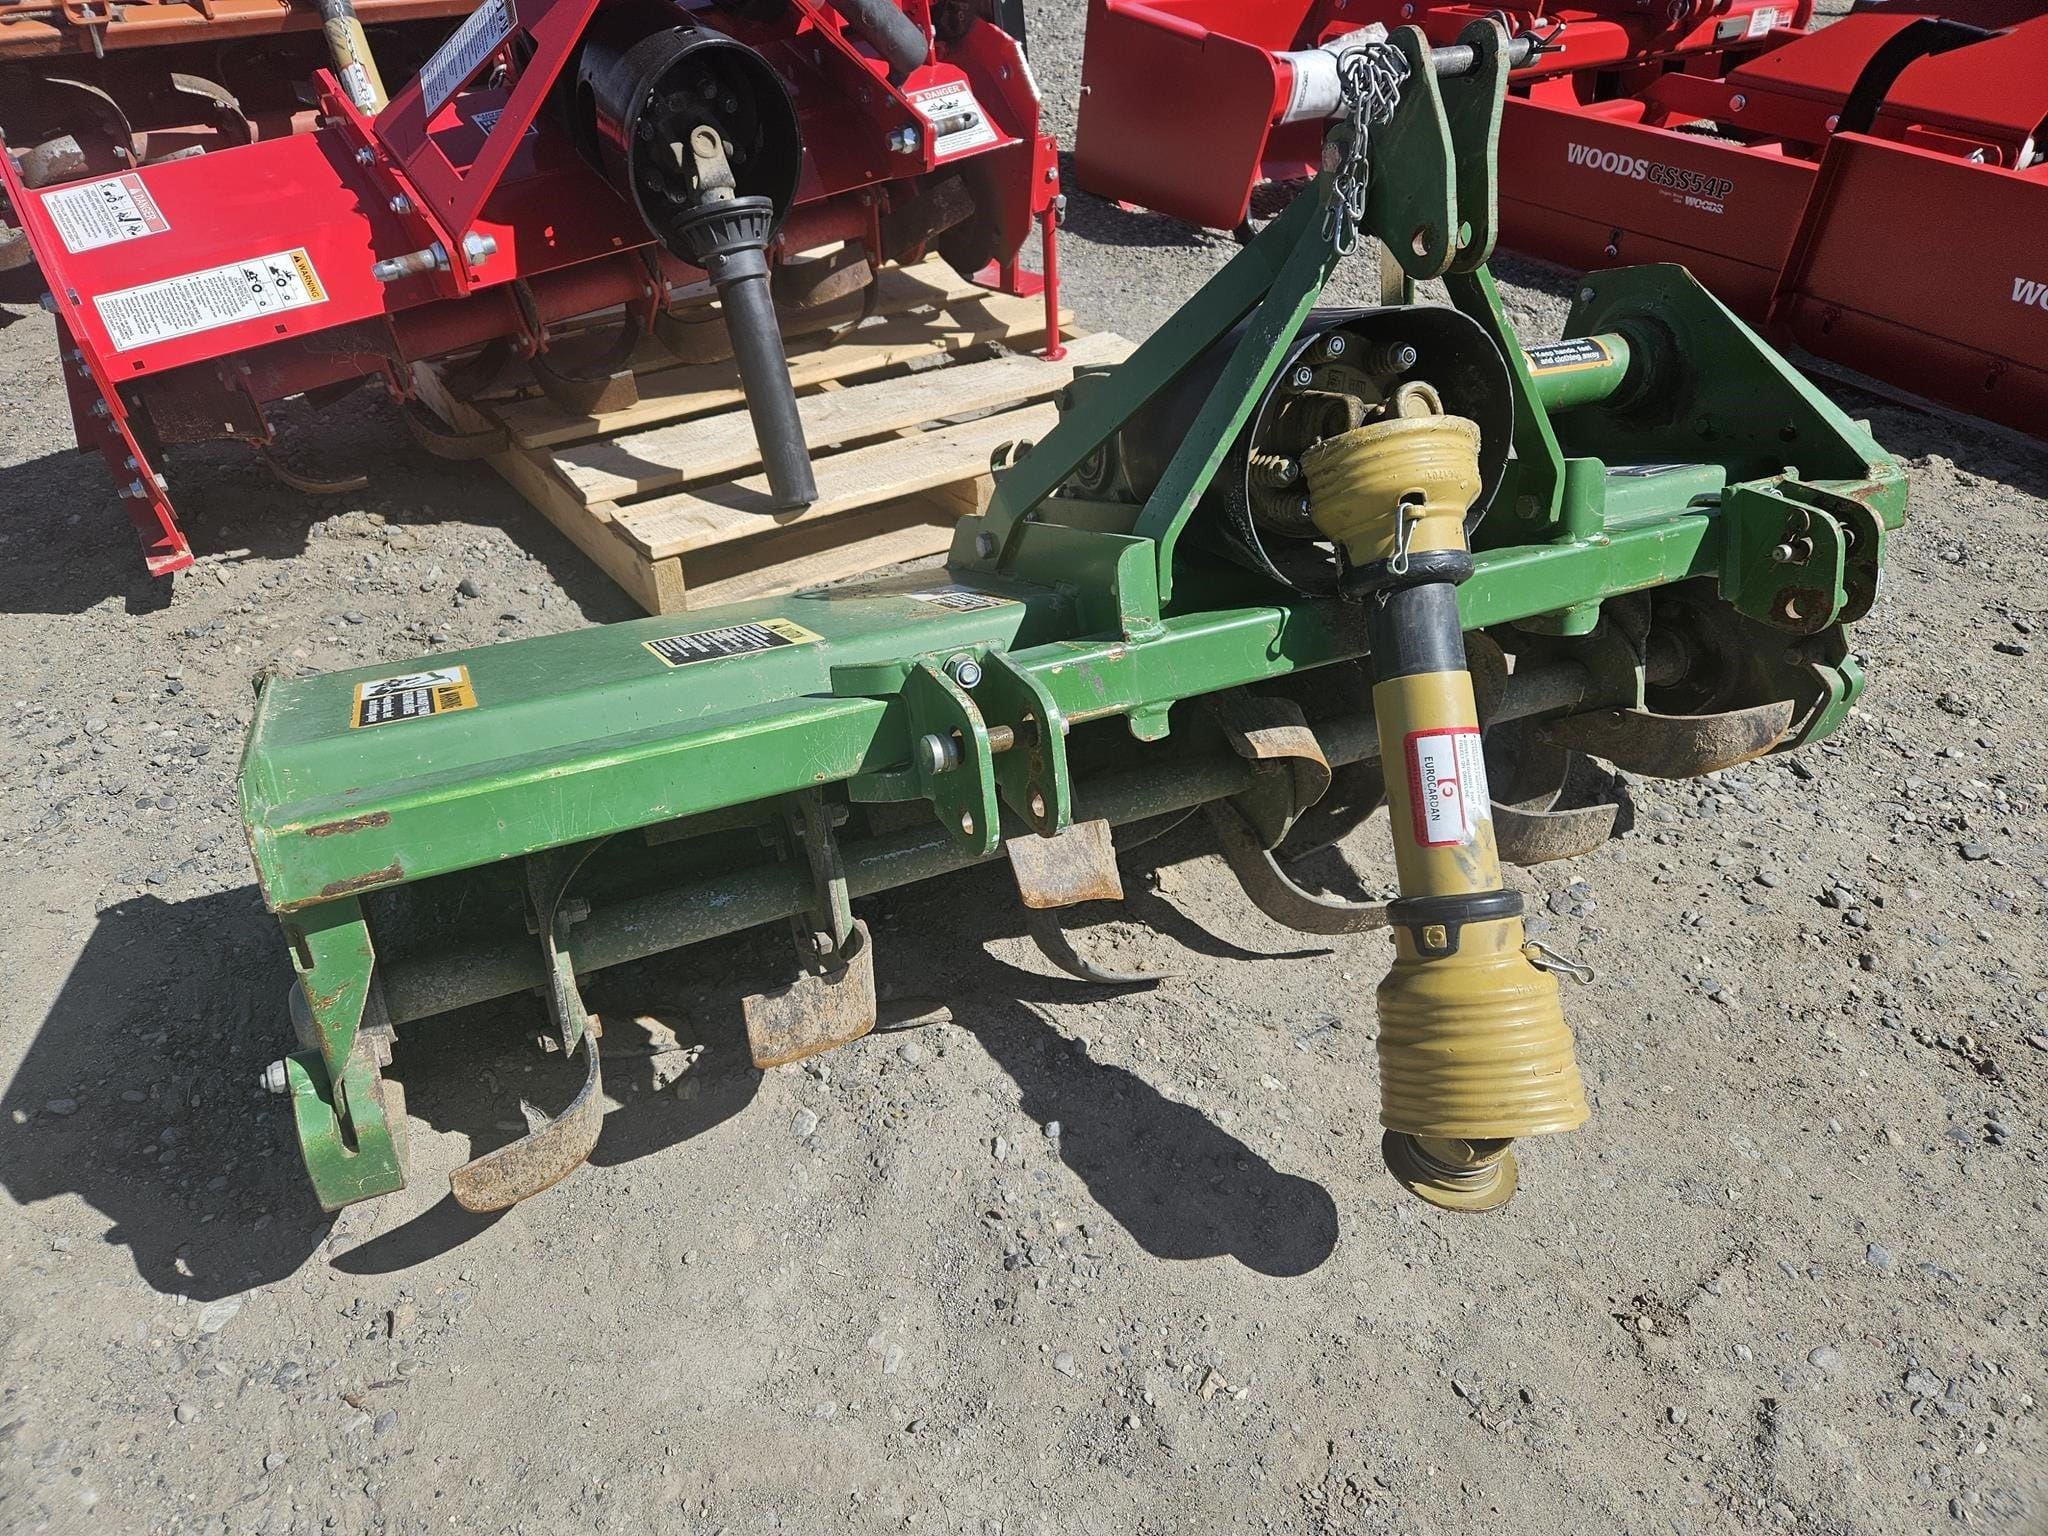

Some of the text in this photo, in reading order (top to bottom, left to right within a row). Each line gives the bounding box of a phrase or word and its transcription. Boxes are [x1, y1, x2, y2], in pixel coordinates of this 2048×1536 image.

[924, 85, 961, 99] DANGER
[1567, 142, 1733, 200] WOODS GSS54P
[131, 193, 157, 221] DANGER
[298, 263, 320, 298] WARNING
[1554, 354, 1582, 363] clothing
[1424, 756, 1440, 821] EUROCARDAN
